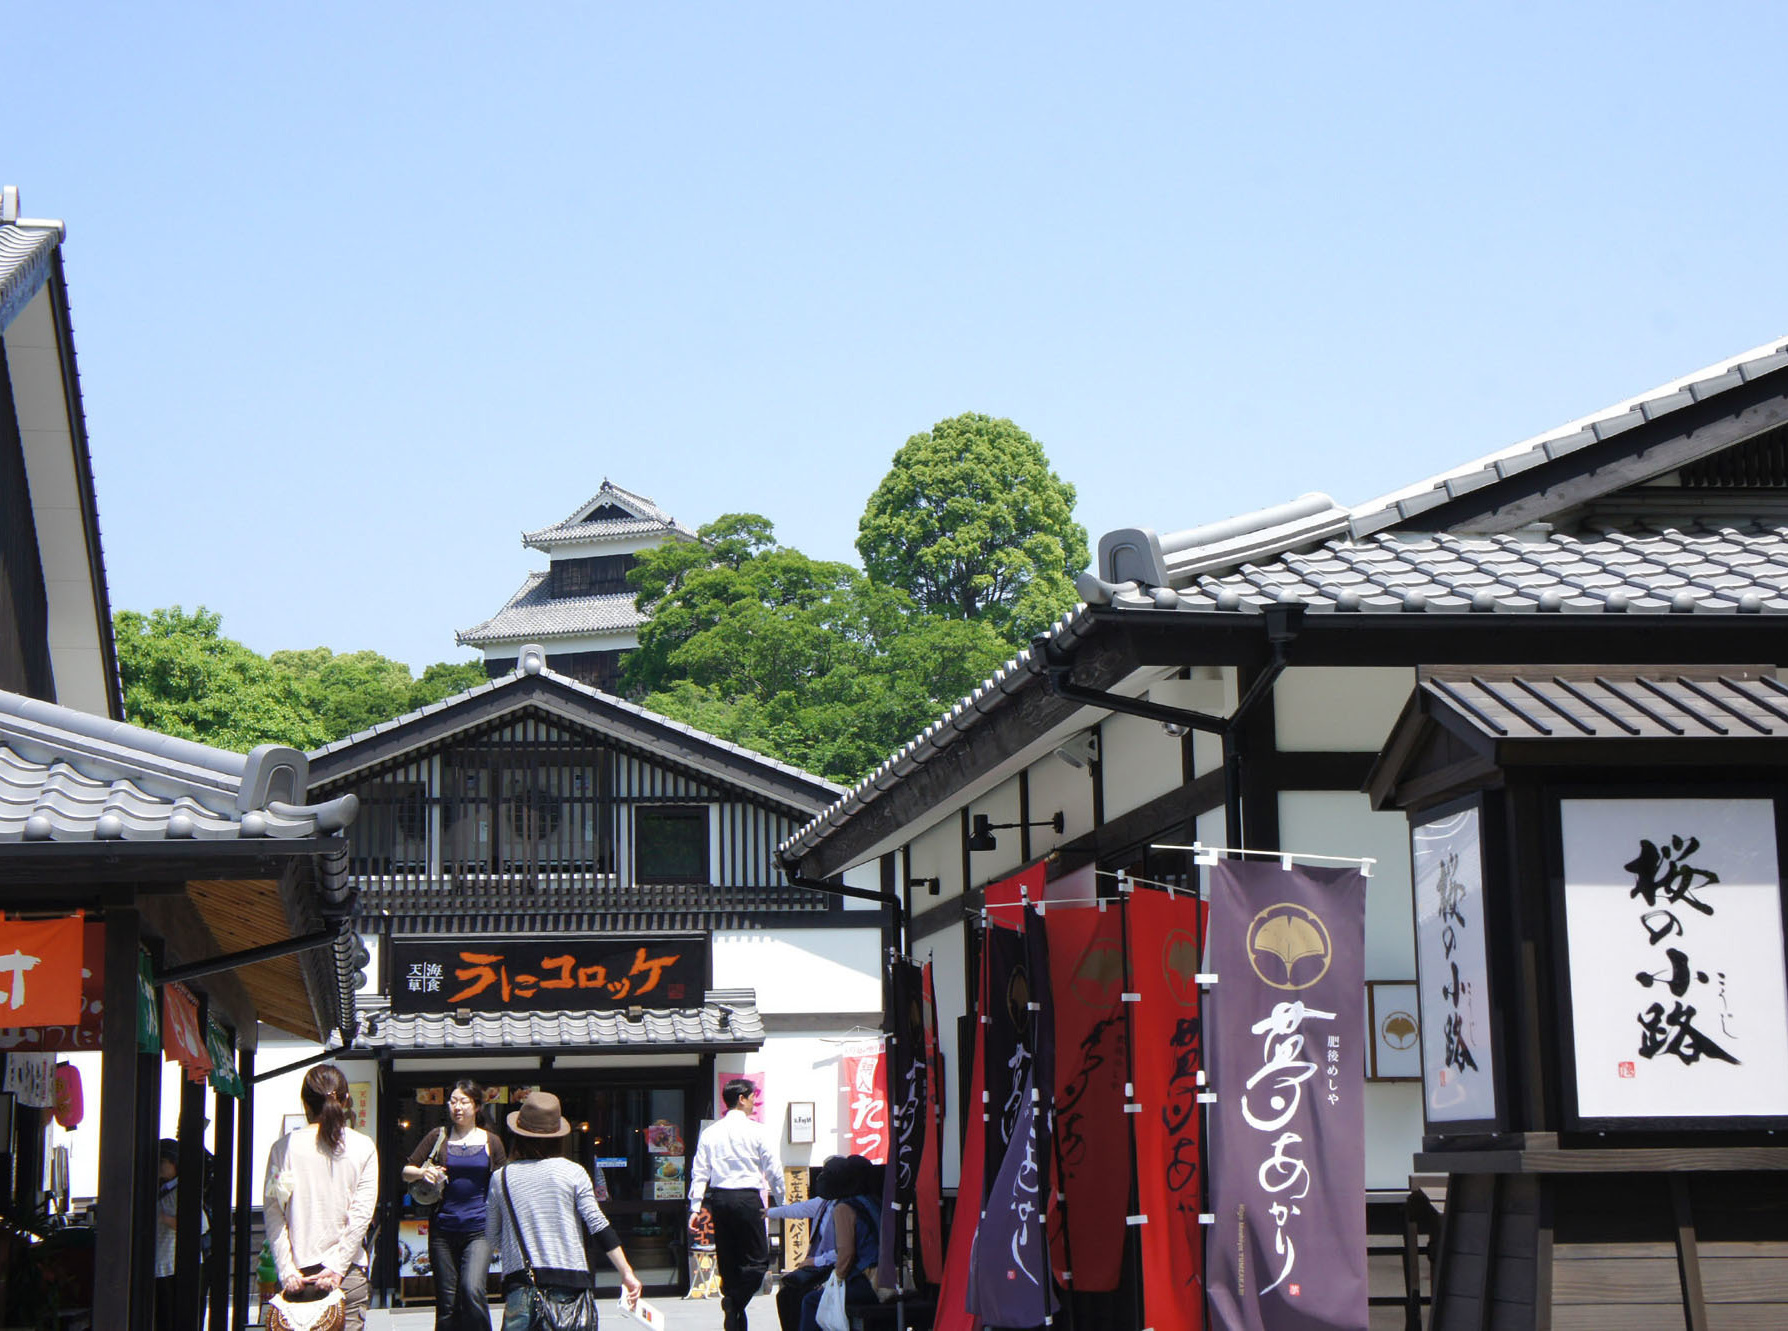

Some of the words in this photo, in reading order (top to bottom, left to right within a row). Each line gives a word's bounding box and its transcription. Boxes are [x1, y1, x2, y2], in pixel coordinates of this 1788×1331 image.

[1436, 852, 1479, 1074] 桜の小路
[1623, 834, 1744, 1067] 桜の小路
[1241, 1000, 1337, 1296] 夢あかり
[1326, 1035, 1340, 1106] 肥後めしや
